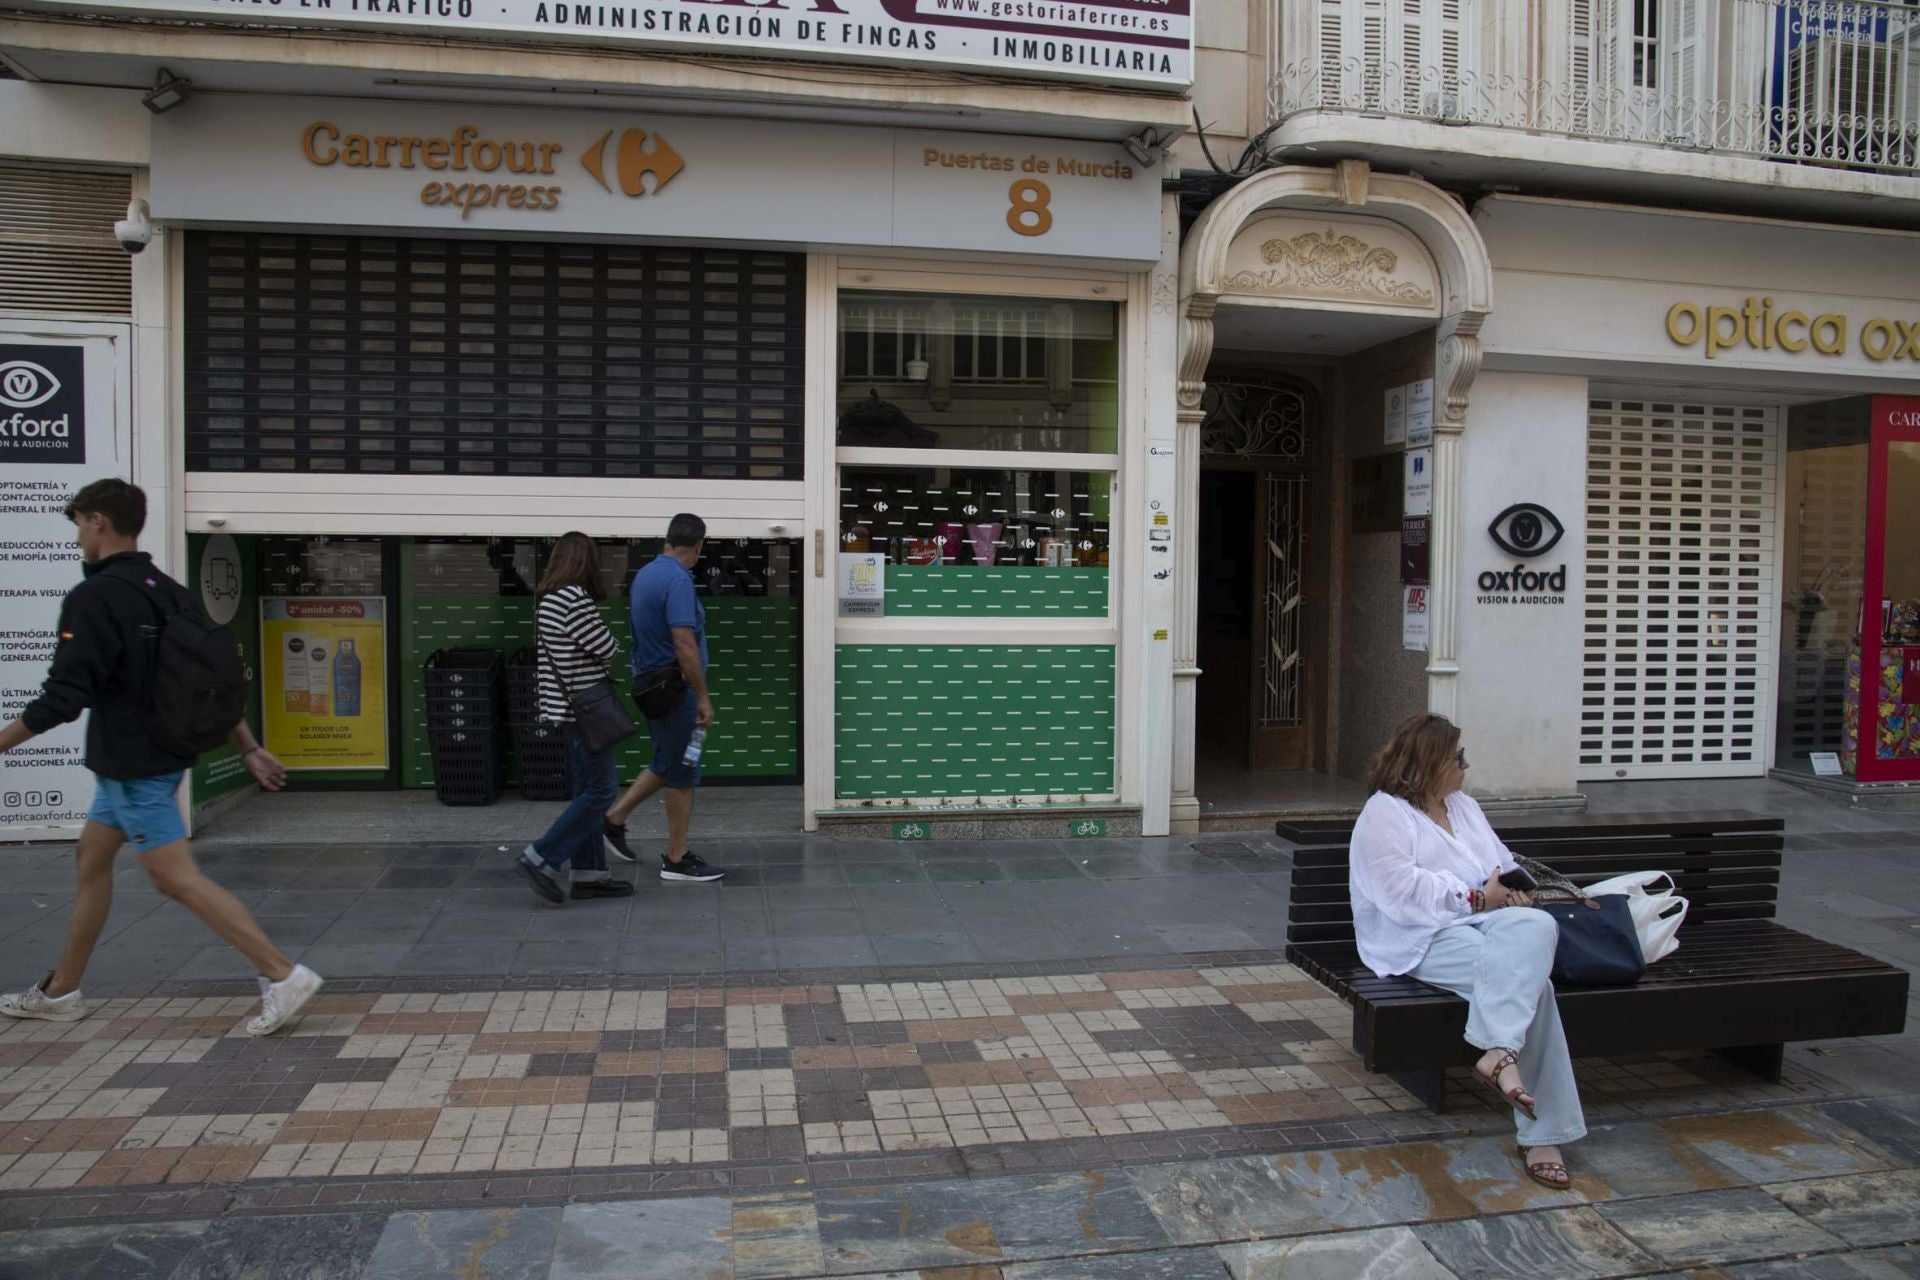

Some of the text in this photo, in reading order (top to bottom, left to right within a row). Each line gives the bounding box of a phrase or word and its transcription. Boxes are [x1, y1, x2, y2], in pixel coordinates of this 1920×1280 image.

[937, 0, 1169, 31] www.gestoriaferrer.es
[535, 2, 781, 38] ADMINISTRACIÓN
[798, 19, 827, 42] DE
[842, 23, 937, 51] FINCAS
[992, 36, 1173, 74] INMOBILIARIA
[302, 120, 562, 175] Carrefour
[923, 148, 1134, 180] Puertas de Murcia
[420, 180, 562, 220] express
[1006, 178, 1053, 237] 8
[1665, 296, 1848, 359] optica
[61, 482, 68, 490] Y
[0, 492, 75, 502] ONTACTOLOGÍ
[41, 505, 47, 514] E
[48, 505, 66, 514] INF
[55, 541, 62, 550] Y
[12, 551, 47, 562] MIOPÍA
[1478, 564, 1567, 592] oxford
[0, 589, 38, 598] TERAPIA
[1477, 595, 1509, 604] VISION
[1520, 595, 1565, 605] AUDICION
[301, 604, 334, 615] unidad
[73, 746, 80, 755] Y
[4, 758, 65, 768] SOLUCIONES
